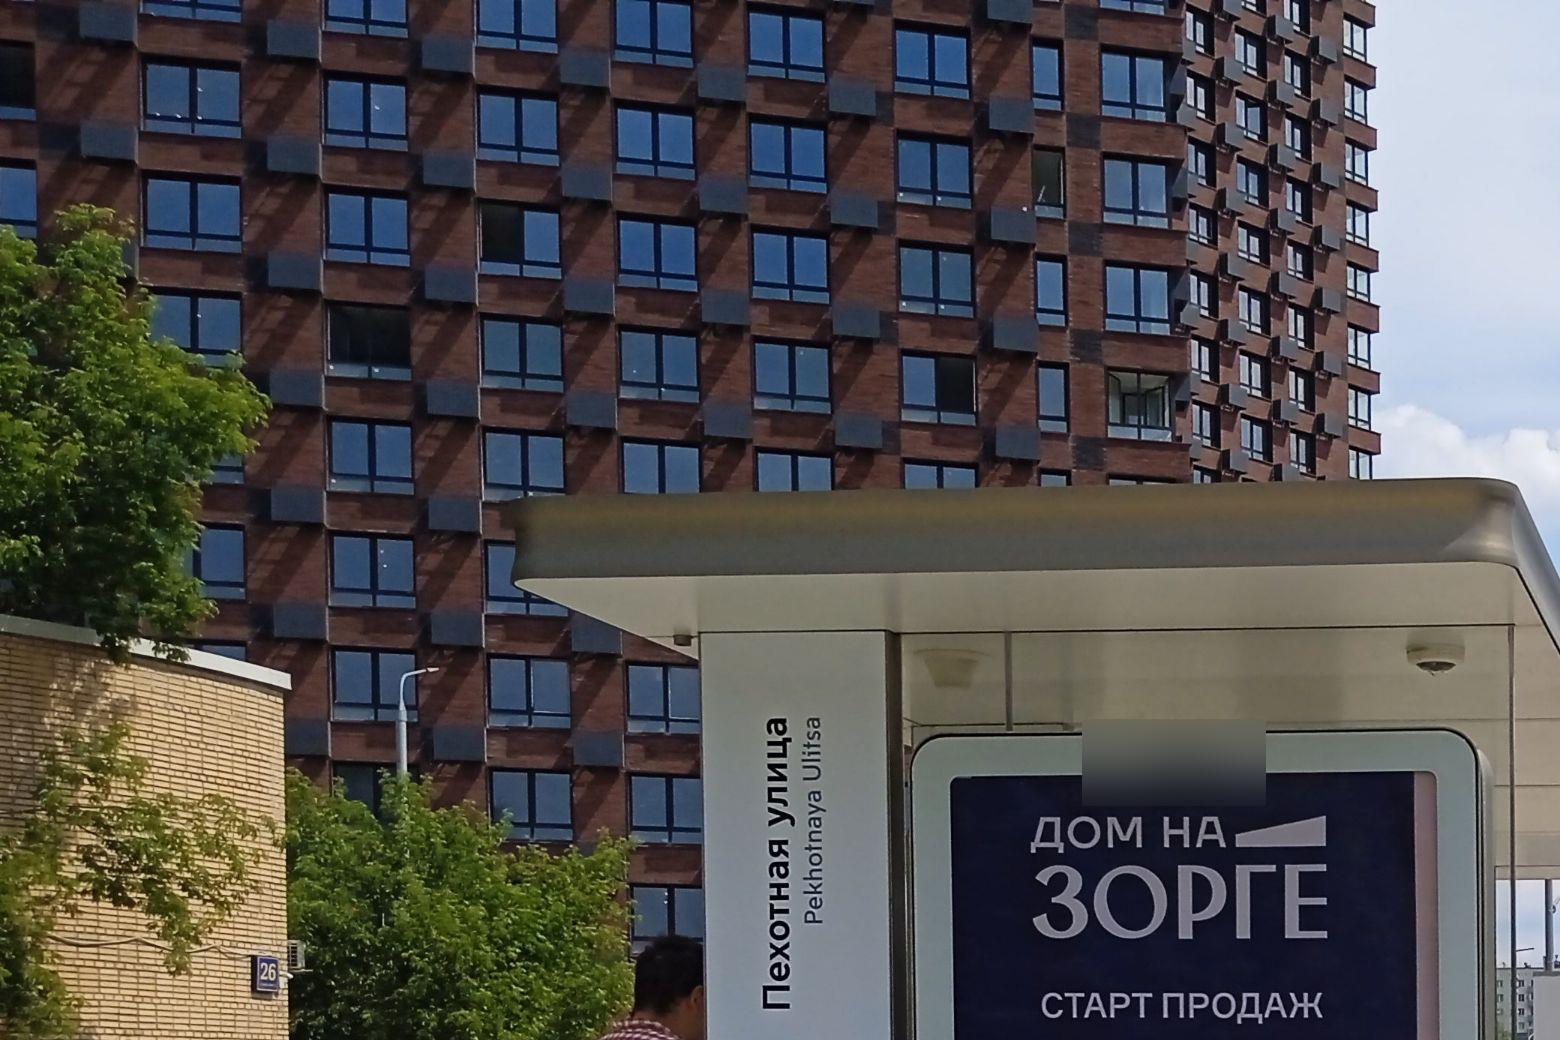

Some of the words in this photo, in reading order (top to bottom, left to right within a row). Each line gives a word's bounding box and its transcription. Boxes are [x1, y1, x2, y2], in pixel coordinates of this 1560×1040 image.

[766, 717, 796, 828] улица
[801, 716, 822, 782] Ulitsa
[803, 790, 826, 924] Pekhotnaya
[1030, 816, 1143, 854] ДОМ
[1163, 816, 1227, 848] НА
[762, 839, 791, 1010] Пехотная
[1032, 863, 1328, 940] ЗОРГЕ
[260, 962, 277, 981] 26
[1041, 992, 1153, 1019] СТАРТ
[1162, 992, 1323, 1025] ПРОДАЖ
